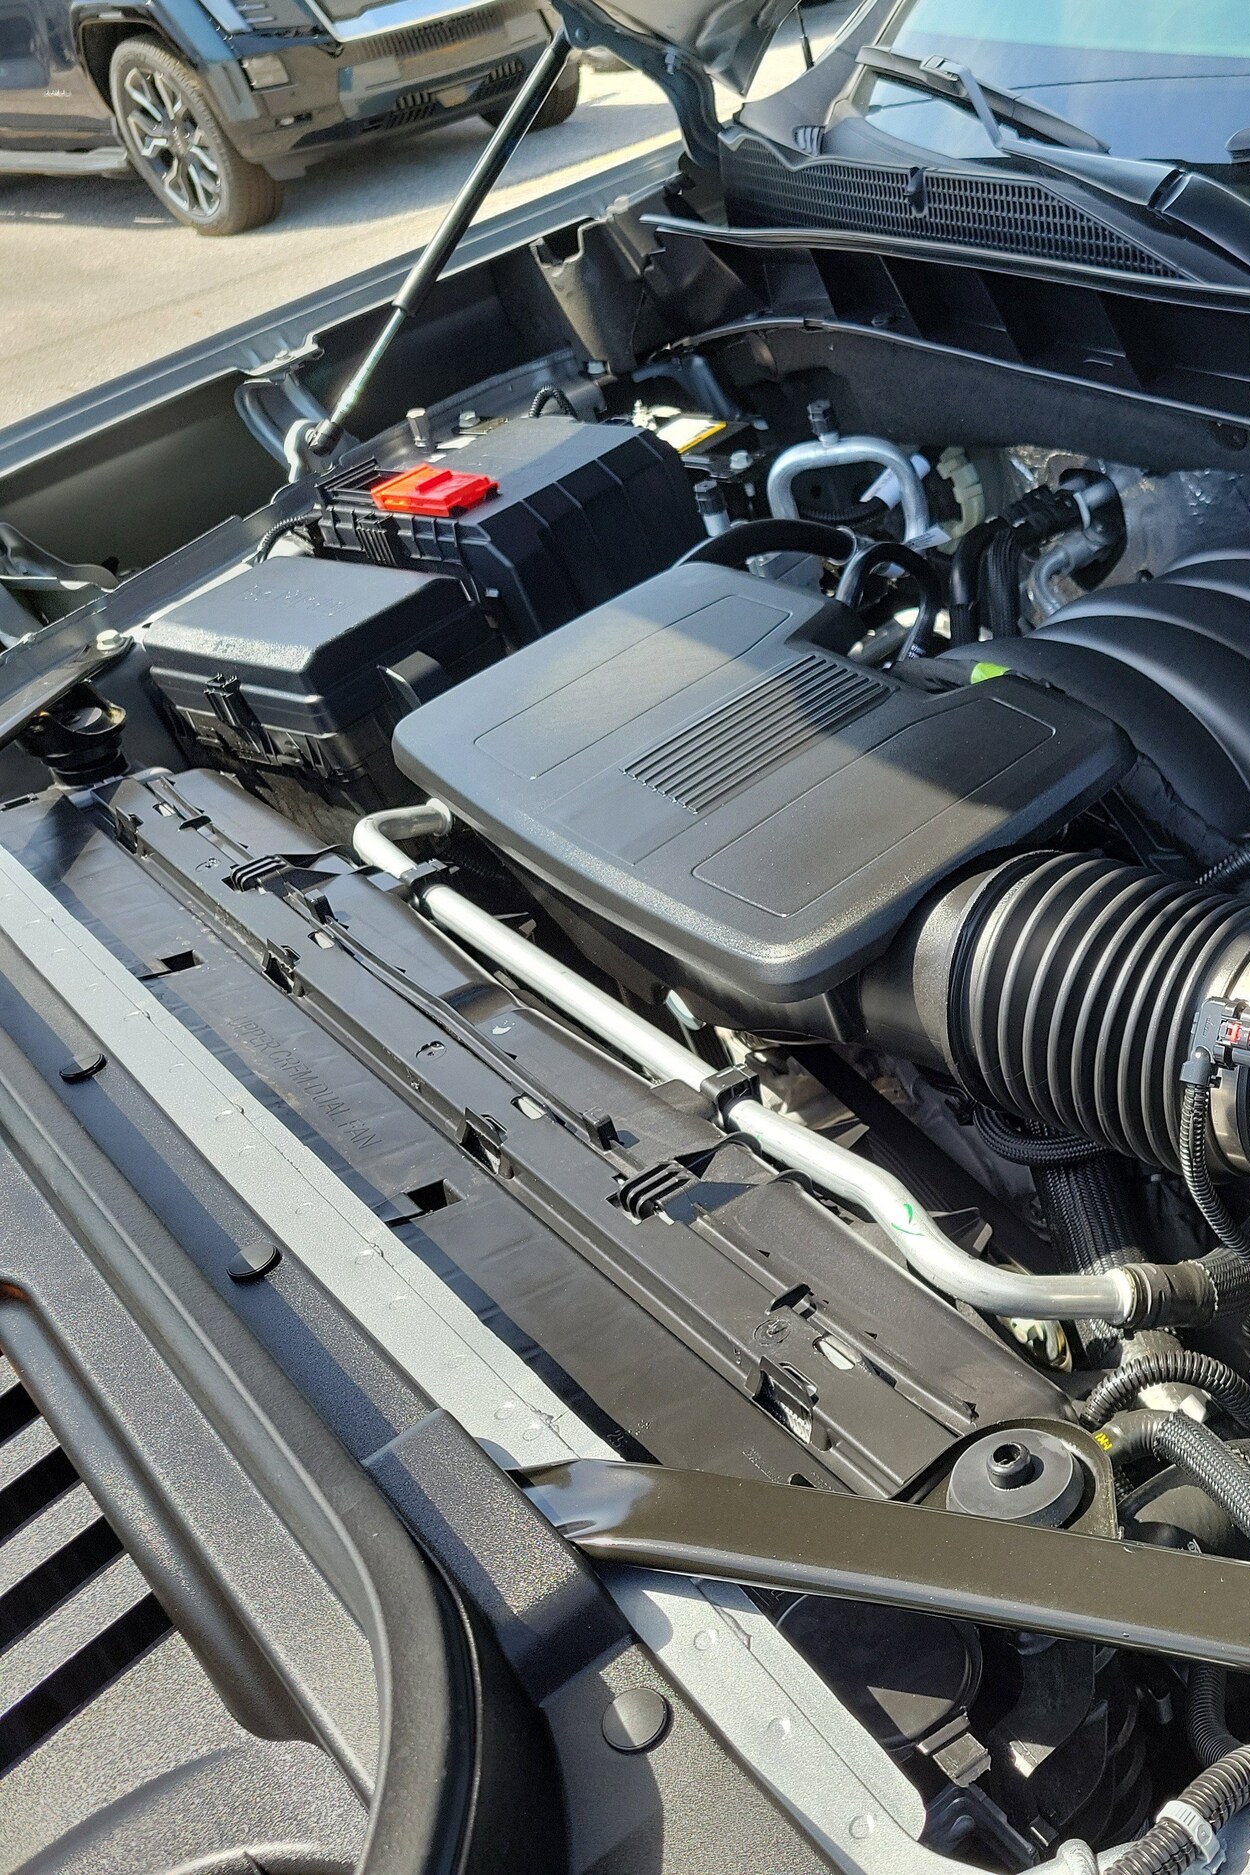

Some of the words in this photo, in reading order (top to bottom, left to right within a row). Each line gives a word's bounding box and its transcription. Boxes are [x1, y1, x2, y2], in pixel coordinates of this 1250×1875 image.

[227, 1014, 280, 1053] UPPER
[302, 1082, 351, 1121] DUAL
[337, 1117, 381, 1150] FAN
